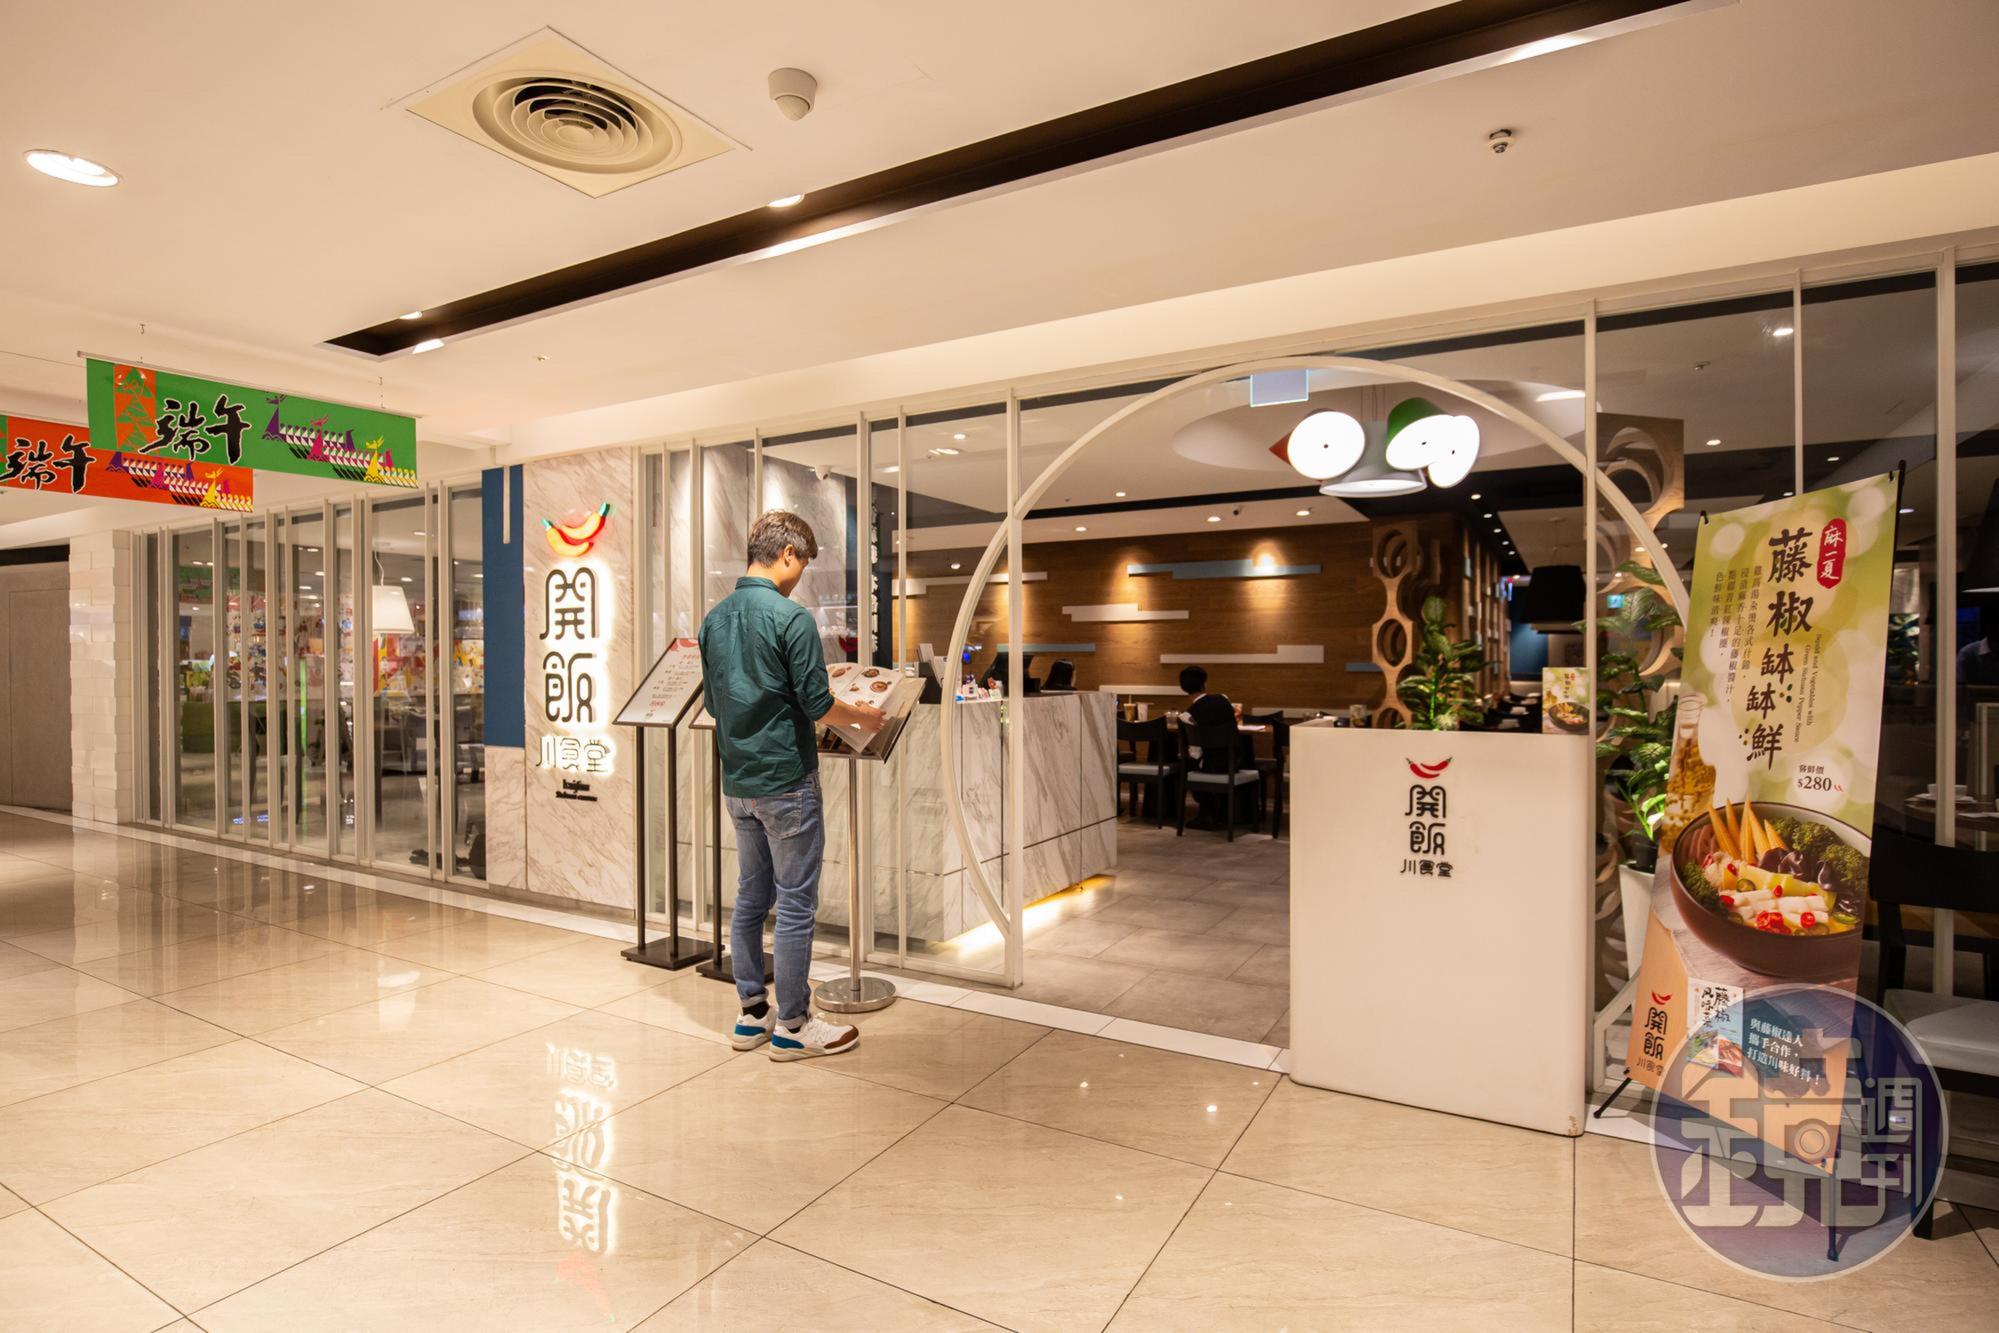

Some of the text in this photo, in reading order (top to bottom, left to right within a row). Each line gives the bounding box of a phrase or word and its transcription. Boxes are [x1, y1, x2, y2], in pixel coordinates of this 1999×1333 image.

[138, 393, 252, 465] 端午
[0, 434, 95, 494] 端午
[1821, 525, 1844, 580] 麻一夏
[539, 567, 598, 723] 開飯
[536, 738, 608, 772] 川食堂
[1797, 776, 1832, 791] $280
[1405, 784, 1446, 855] 開飯
[1644, 1007, 1667, 1061] 開飯
